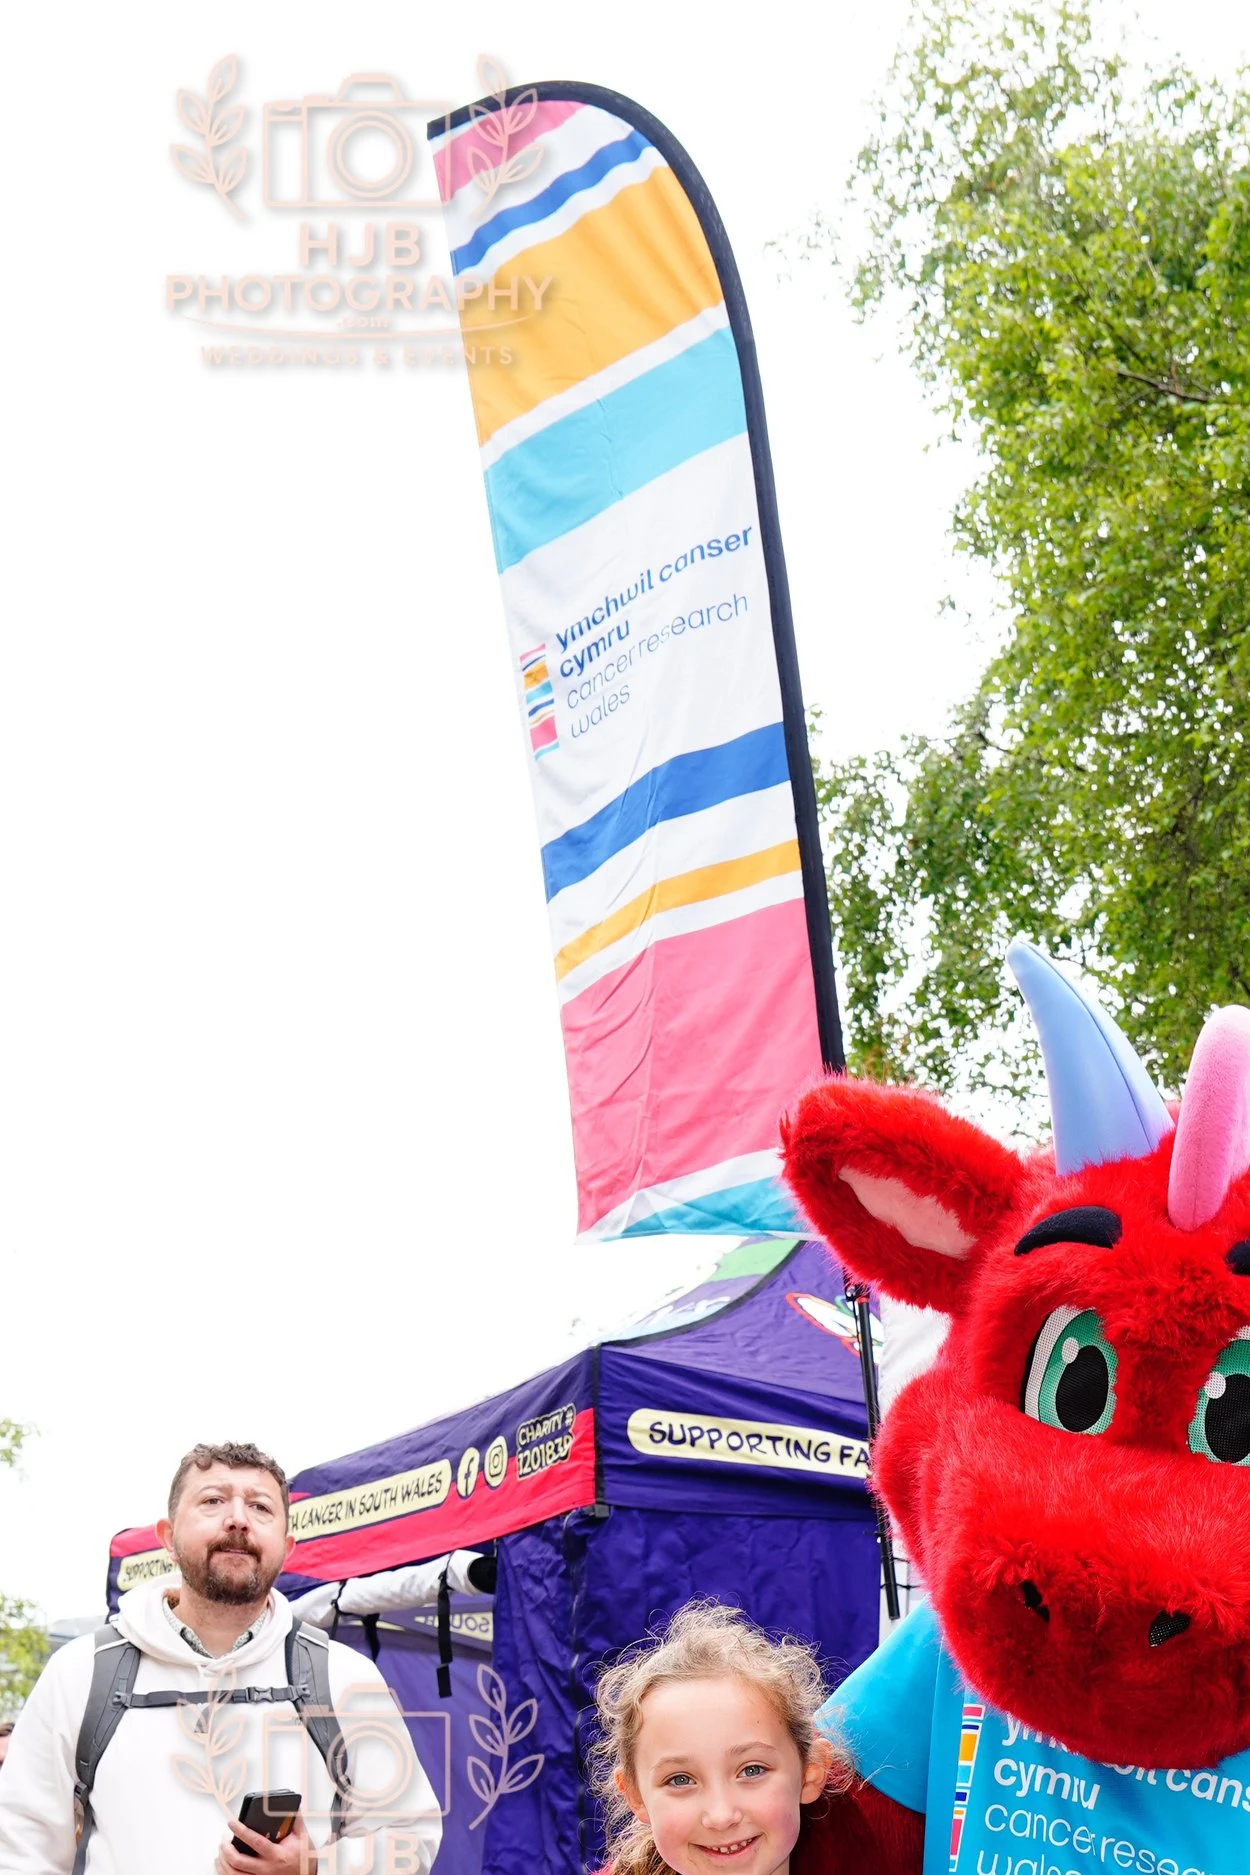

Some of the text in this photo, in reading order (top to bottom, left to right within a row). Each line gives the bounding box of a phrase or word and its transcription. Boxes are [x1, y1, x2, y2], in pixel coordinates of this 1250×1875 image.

[556, 526, 752, 653] ymchwil canser
[560, 620, 631, 677] cymru
[567, 594, 748, 709] cancer research
[571, 684, 631, 738] wales
[519, 1411, 563, 1446] CHARITY
[649, 1421, 831, 1463] SUPPORTING
[300, 1501, 342, 1531] CANCER
[344, 1499, 356, 1520] IN
[358, 1489, 398, 1516] SOUTH
[401, 1471, 443, 1505] WALES
[994, 1757, 1100, 1811] cymru
[985, 1804, 1096, 1855] cancer
